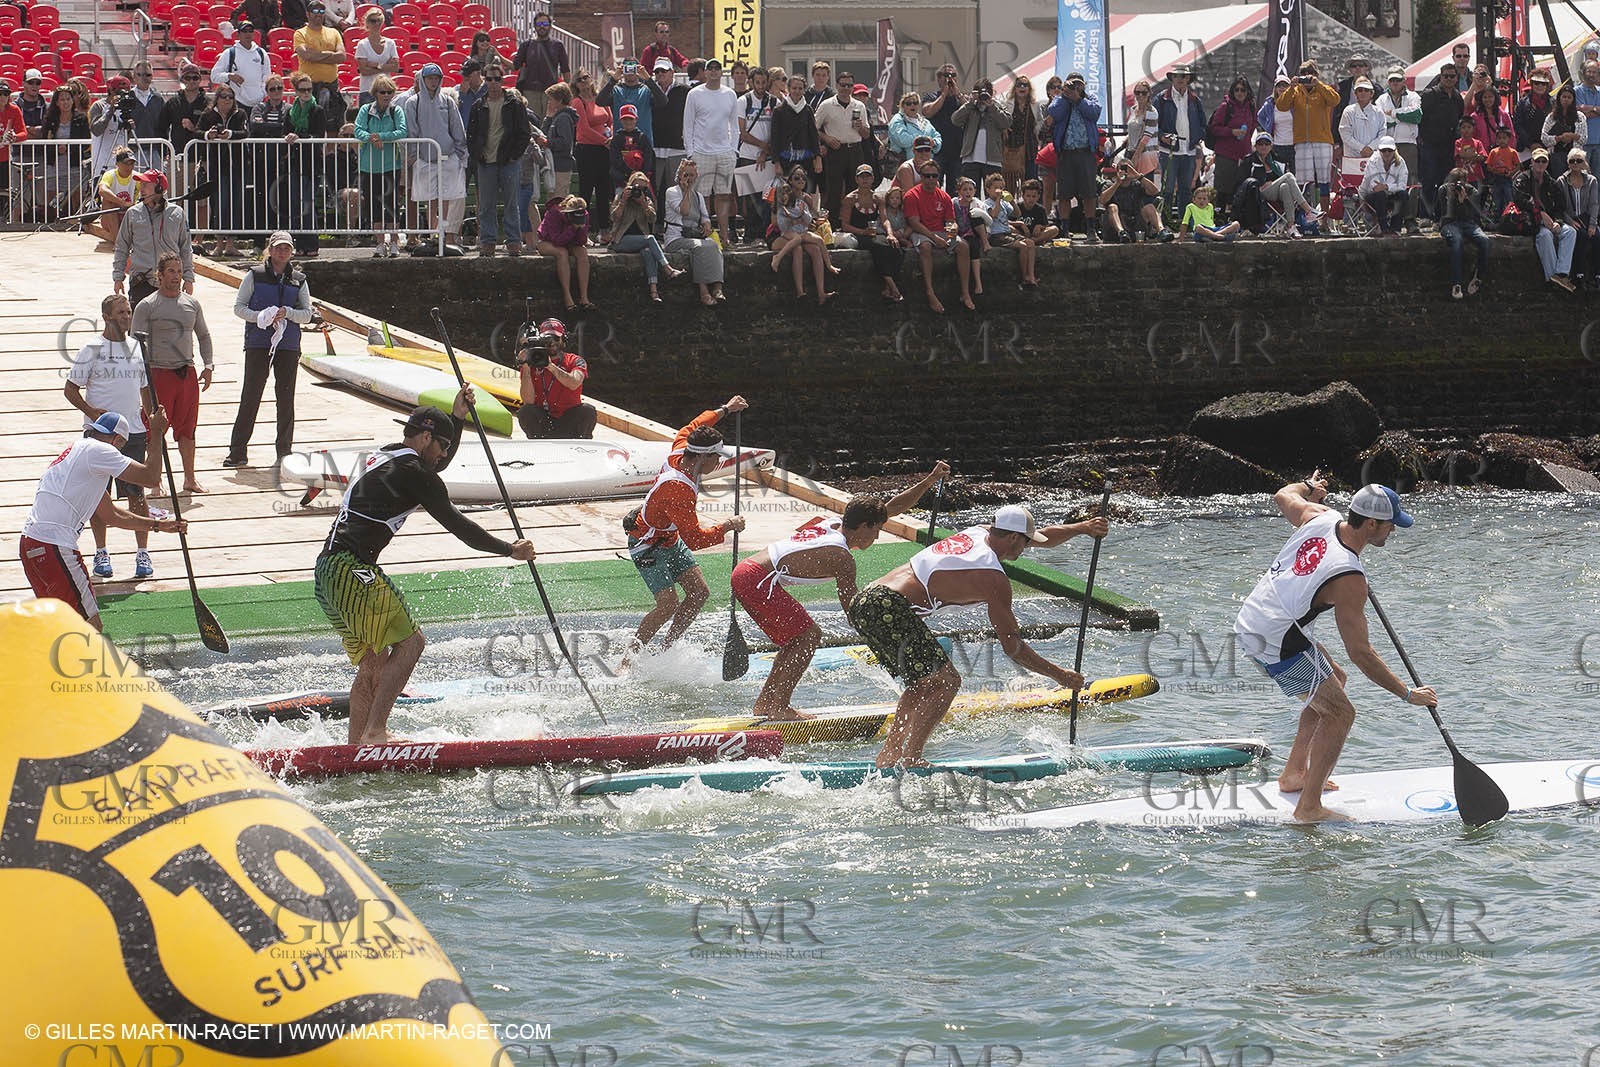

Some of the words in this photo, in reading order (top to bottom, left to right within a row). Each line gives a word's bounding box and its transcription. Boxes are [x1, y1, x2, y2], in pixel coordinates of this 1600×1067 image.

[353, 743, 444, 762] FANATIC
[656, 734, 724, 751] FANATIC
[93, 771, 176, 822] SAN
[151, 824, 409, 952] 101
[254, 943, 347, 1007] SURF
